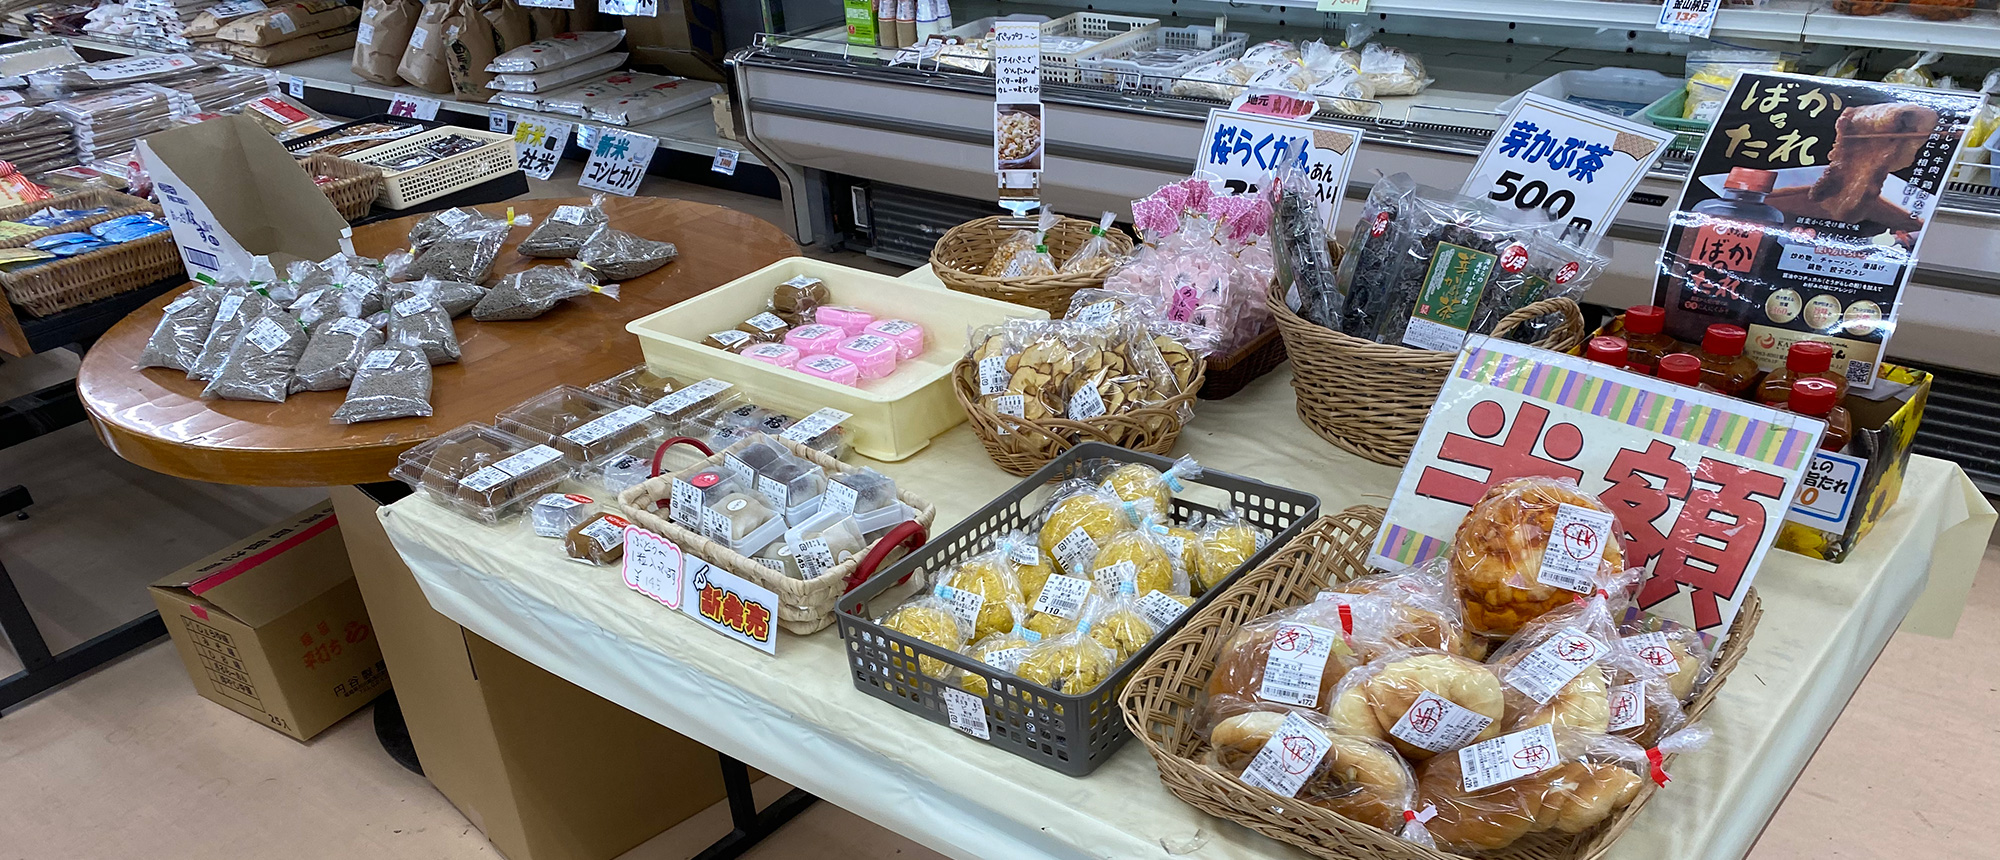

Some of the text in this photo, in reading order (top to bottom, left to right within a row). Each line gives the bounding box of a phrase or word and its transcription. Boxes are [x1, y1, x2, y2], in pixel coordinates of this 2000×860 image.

[996, 33, 1037, 41] ポップコーン
[997, 55, 1035, 64] フライパンで
[1247, 94, 1270, 107] 地元
[1741, 80, 1852, 118] ばか
[515, 121, 547, 148] 新米
[594, 134, 630, 161] 新米
[1724, 124, 1815, 166] たれ
[1499, 120, 1614, 184] 芽かぶ茶
[588, 160, 645, 190] コシヒカリ
[1310, 162, 1333, 183] あん
[1315, 183, 1338, 204] 入り
[1699, 237, 1753, 266] ばか
[1414, 400, 1786, 630] 半額
[700, 584, 771, 642] 新発売
[268, 714, 291, 731] 25入
